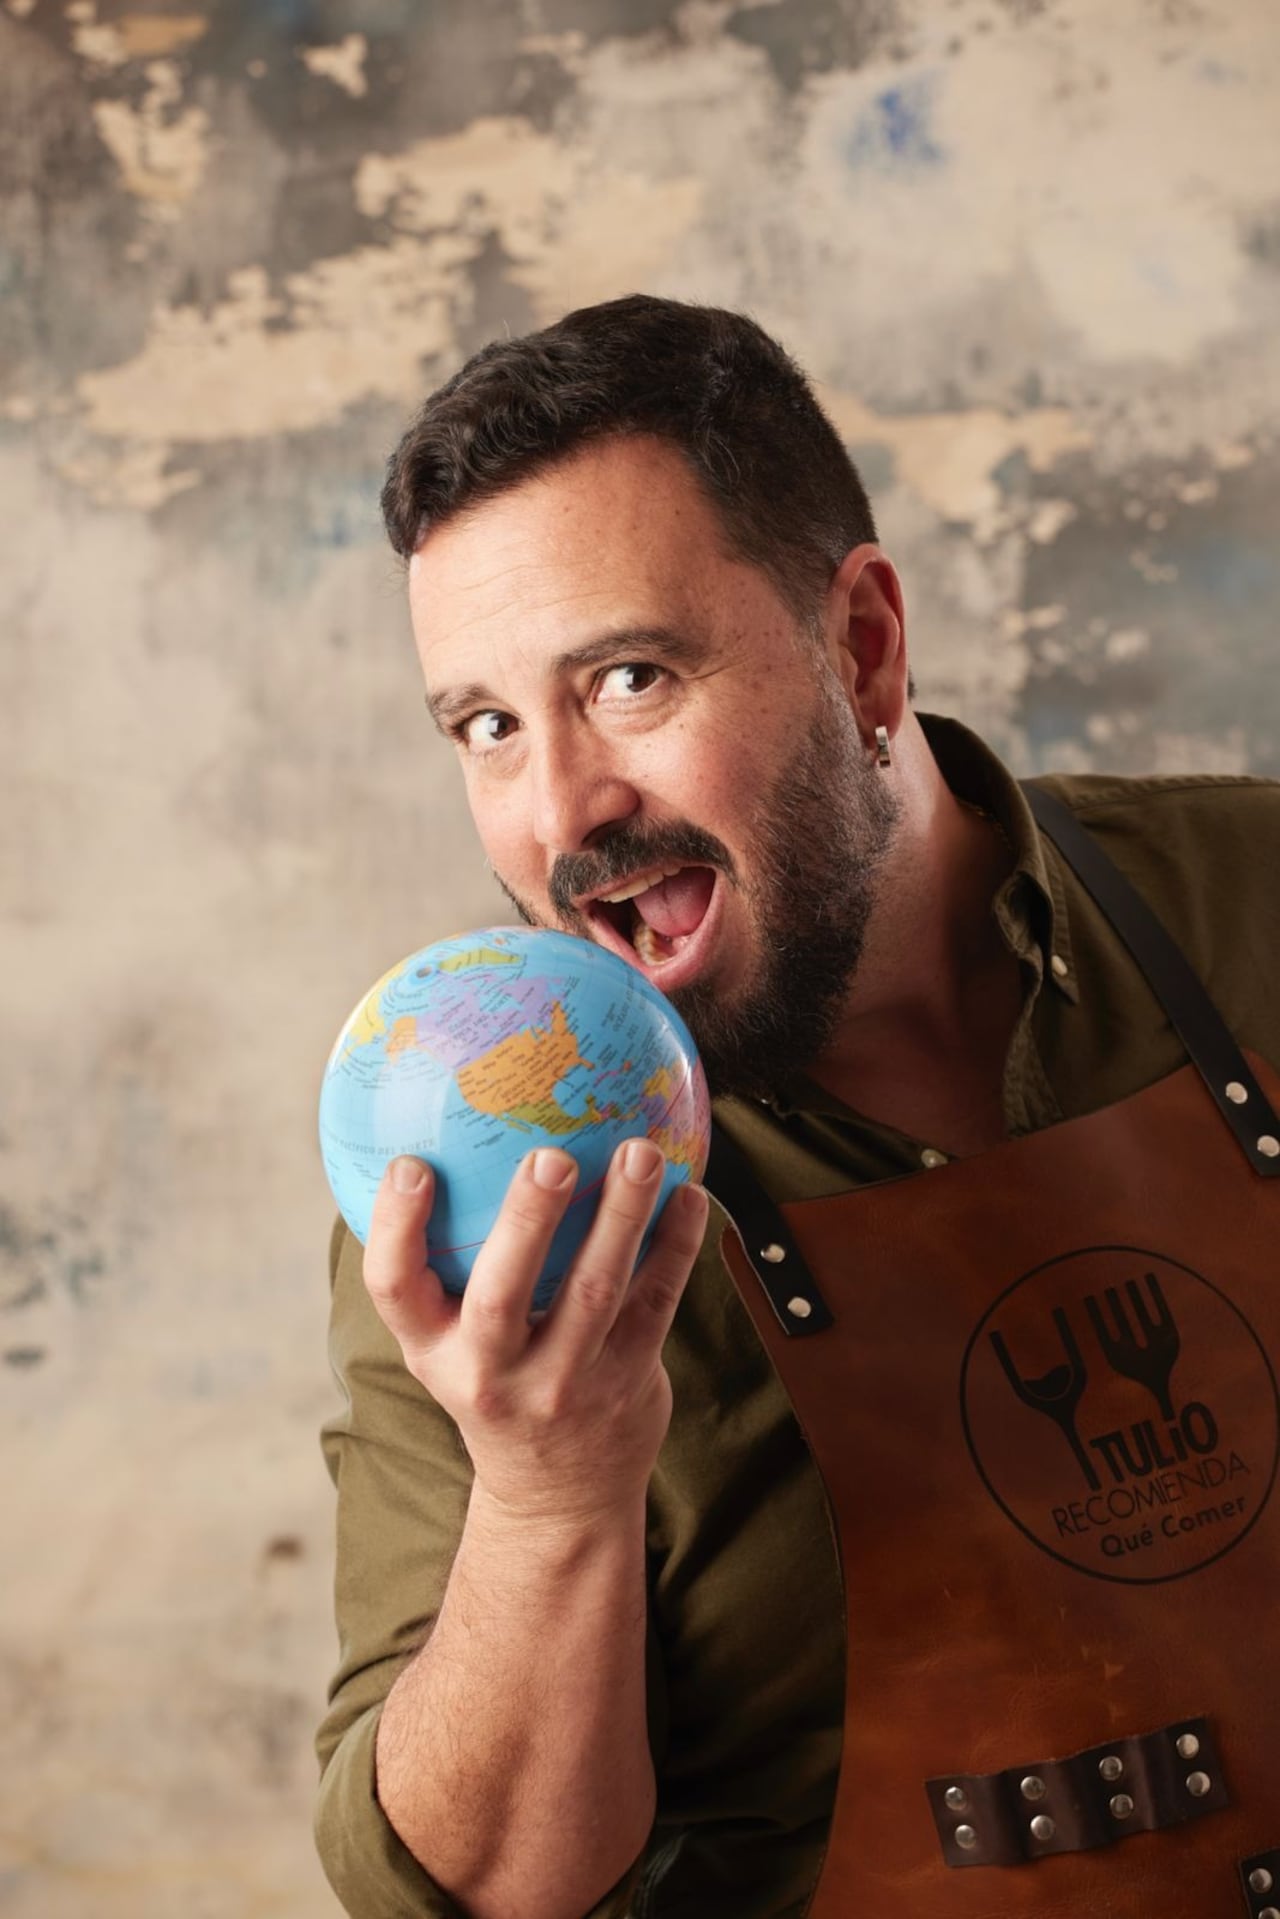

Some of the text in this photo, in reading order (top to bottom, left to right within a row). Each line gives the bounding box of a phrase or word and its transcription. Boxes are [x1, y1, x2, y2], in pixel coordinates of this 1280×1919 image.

[1052, 1451, 1251, 1537] RECOMIENDA
[1100, 1497, 1247, 1558] Qué Comer
